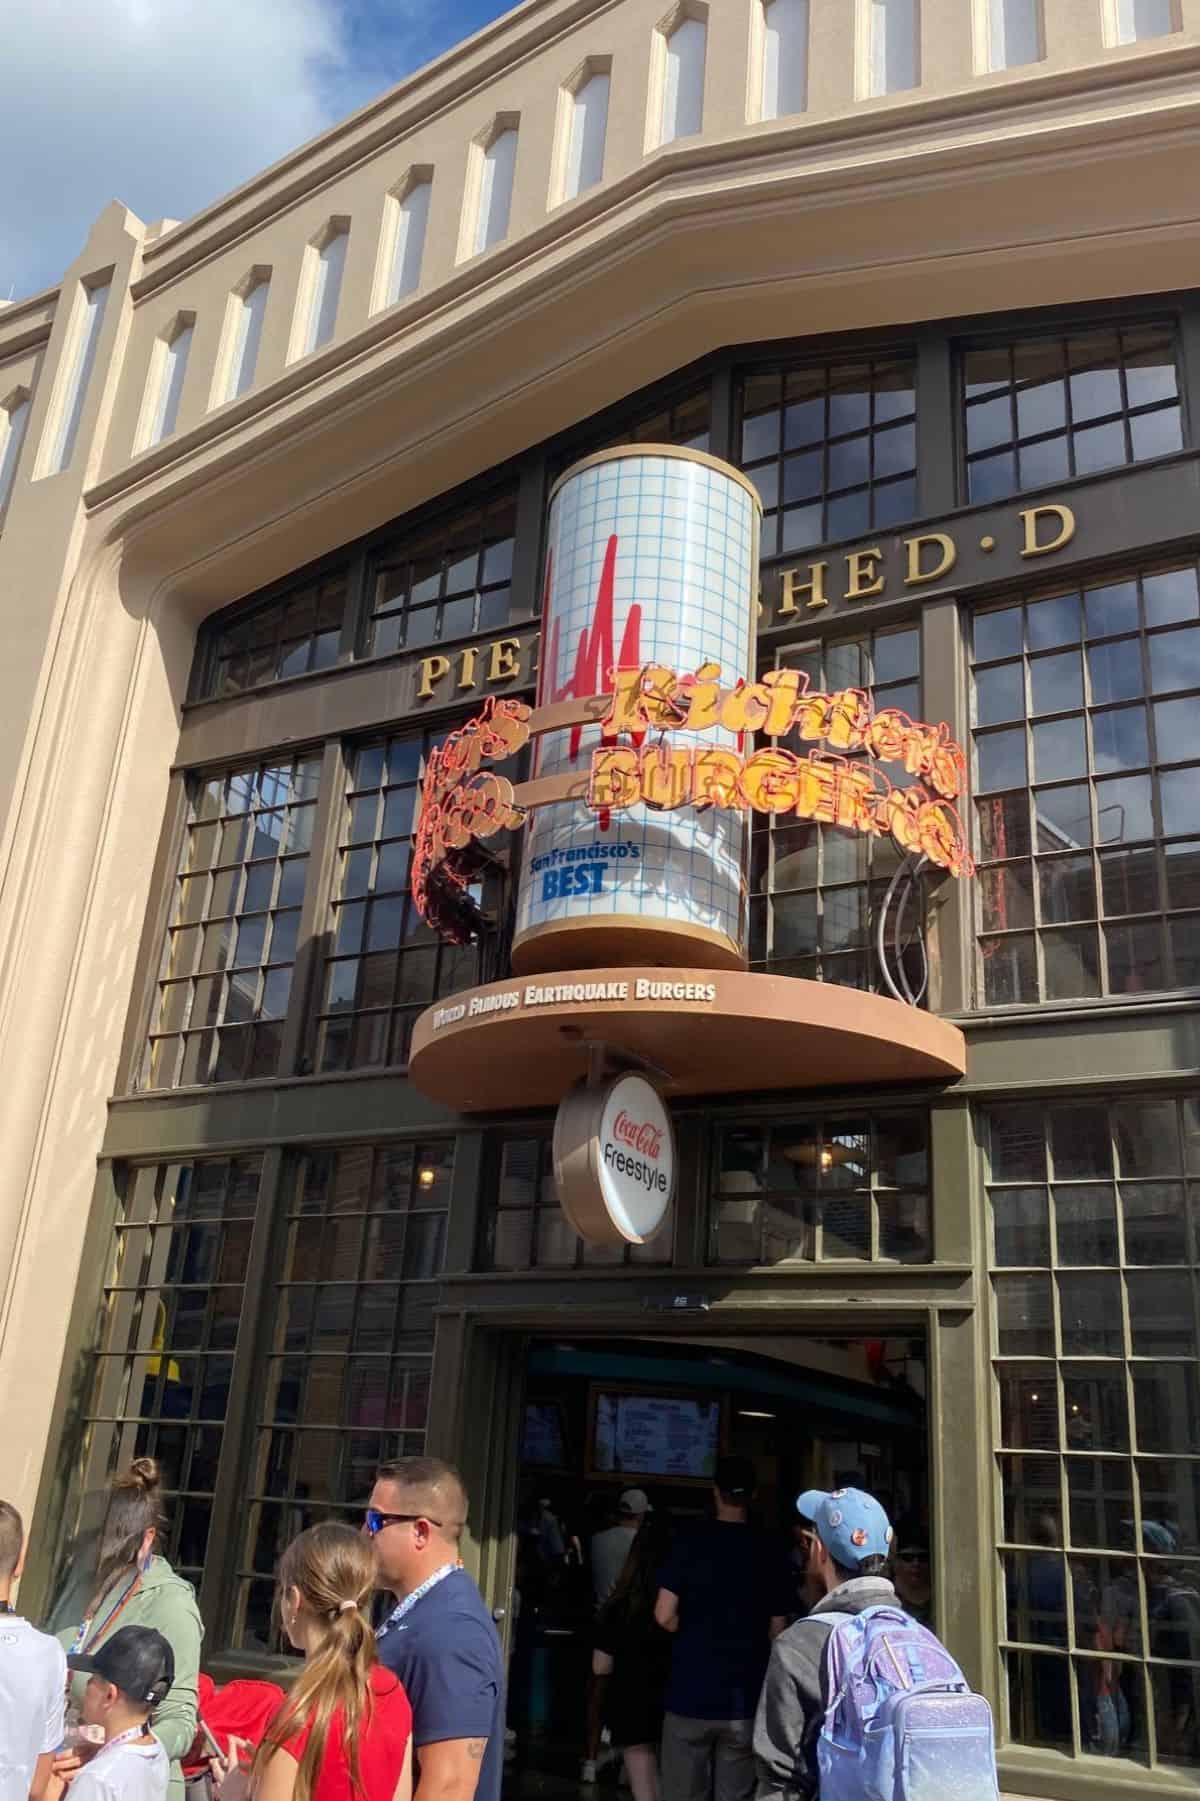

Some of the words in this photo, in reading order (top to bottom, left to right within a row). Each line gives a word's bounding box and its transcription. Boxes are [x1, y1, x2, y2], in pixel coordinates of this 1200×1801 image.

[757, 532, 956, 617] HED
[1019, 503, 1076, 560] D
[586, 745, 893, 837] BURGER
[542, 862, 609, 902] BEST
[468, 991, 520, 1017] FAMOUS
[524, 981, 629, 1006] EARTHQUAKE
[635, 977, 717, 1001] BURGERS
[604, 1143, 667, 1193] Freestyle
